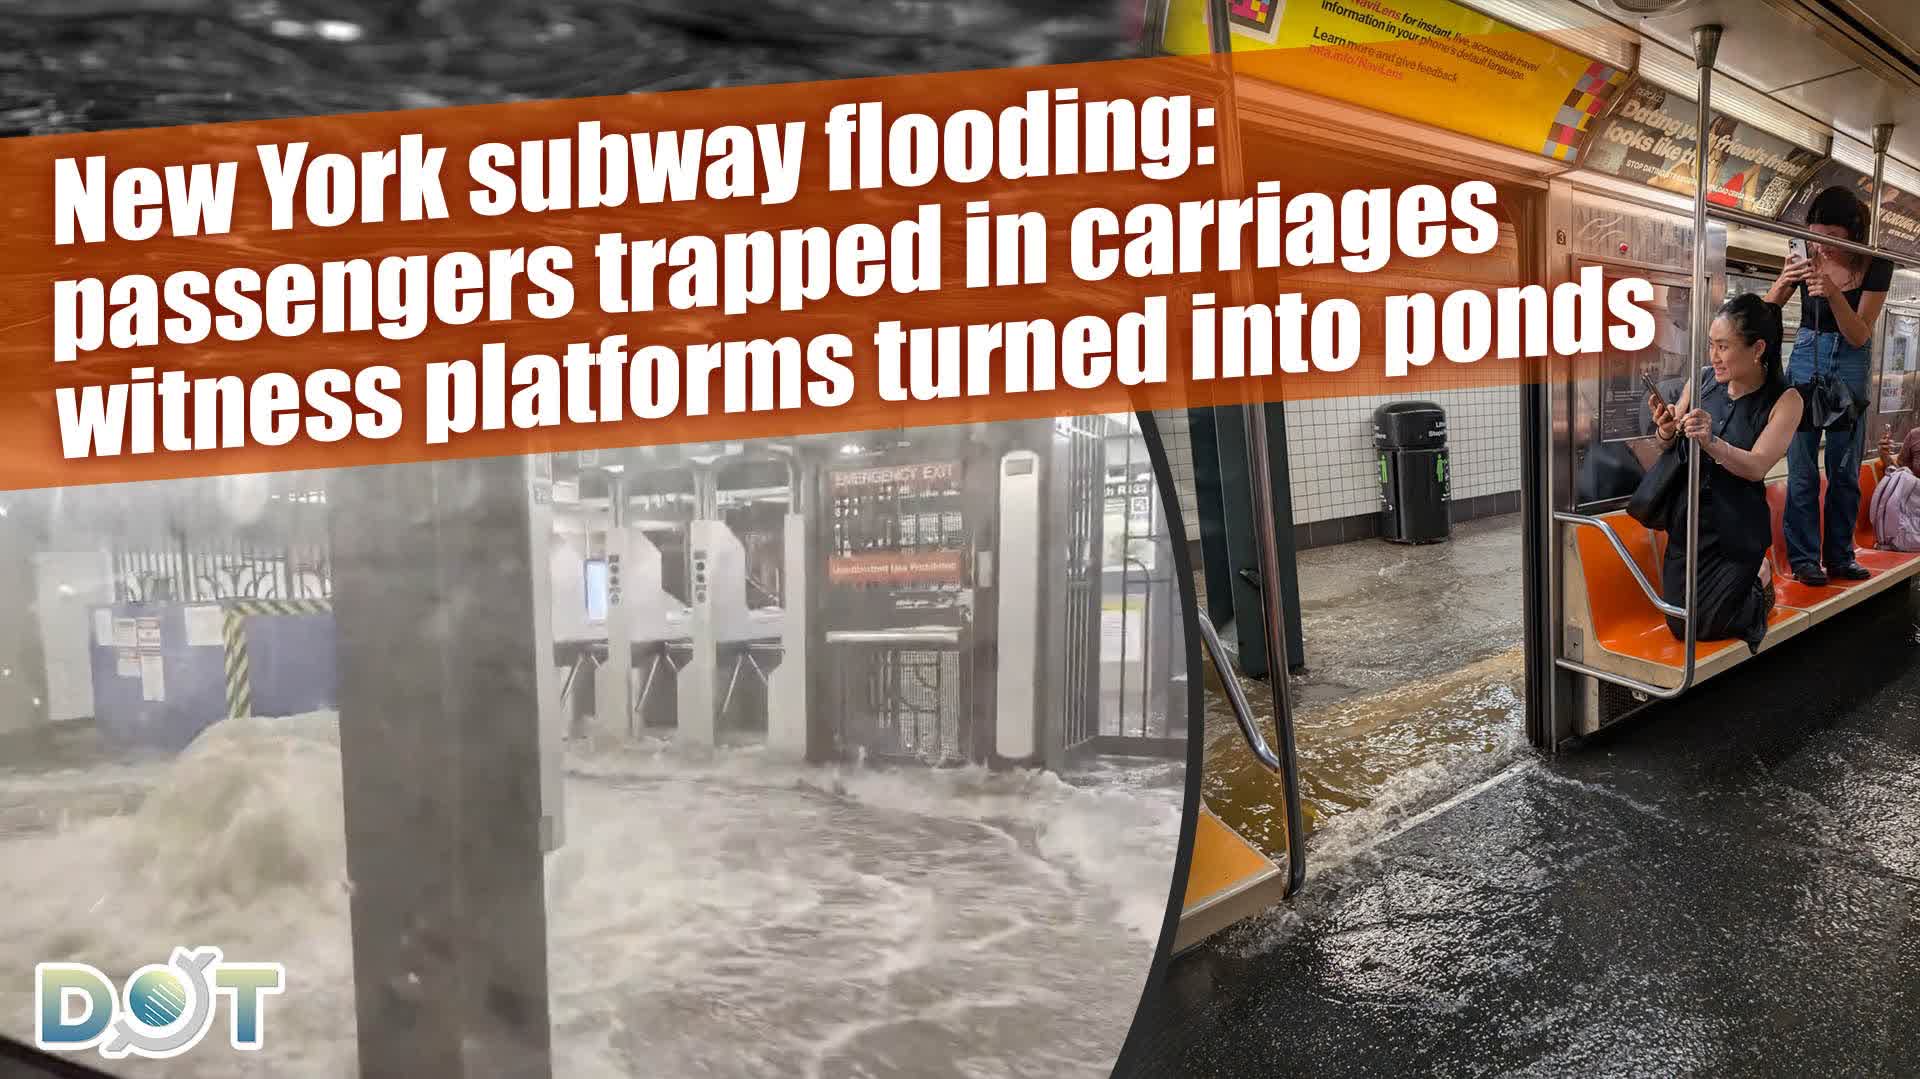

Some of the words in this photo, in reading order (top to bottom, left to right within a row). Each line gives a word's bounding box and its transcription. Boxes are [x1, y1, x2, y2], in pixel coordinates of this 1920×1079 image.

[1312, 26, 1346, 46] Learn
[1345, 38, 1376, 56] more
[1375, 45, 1396, 62] and
[1394, 52, 1418, 71] give
[1416, 59, 1458, 82] feedback
[1321, 1, 1386, 30] information
[1384, 21, 1396, 34] in
[1395, 26, 1421, 42] your
[1419, 35, 1458, 57] phone's
[1456, 48, 1489, 66] default
[1486, 58, 1526, 81] language.
[1401, 12, 1418, 25] for
[1417, 18, 1453, 40] instant,
[1453, 32, 1470, 46] live,
[1470, 39, 1521, 64] accessible
[1519, 57, 1541, 72] travel
[1604, 120, 1655, 153] looks
[1651, 135, 1683, 161] like
[1620, 99, 1681, 137] Dating
[1625, 159, 1645, 172] STOP
